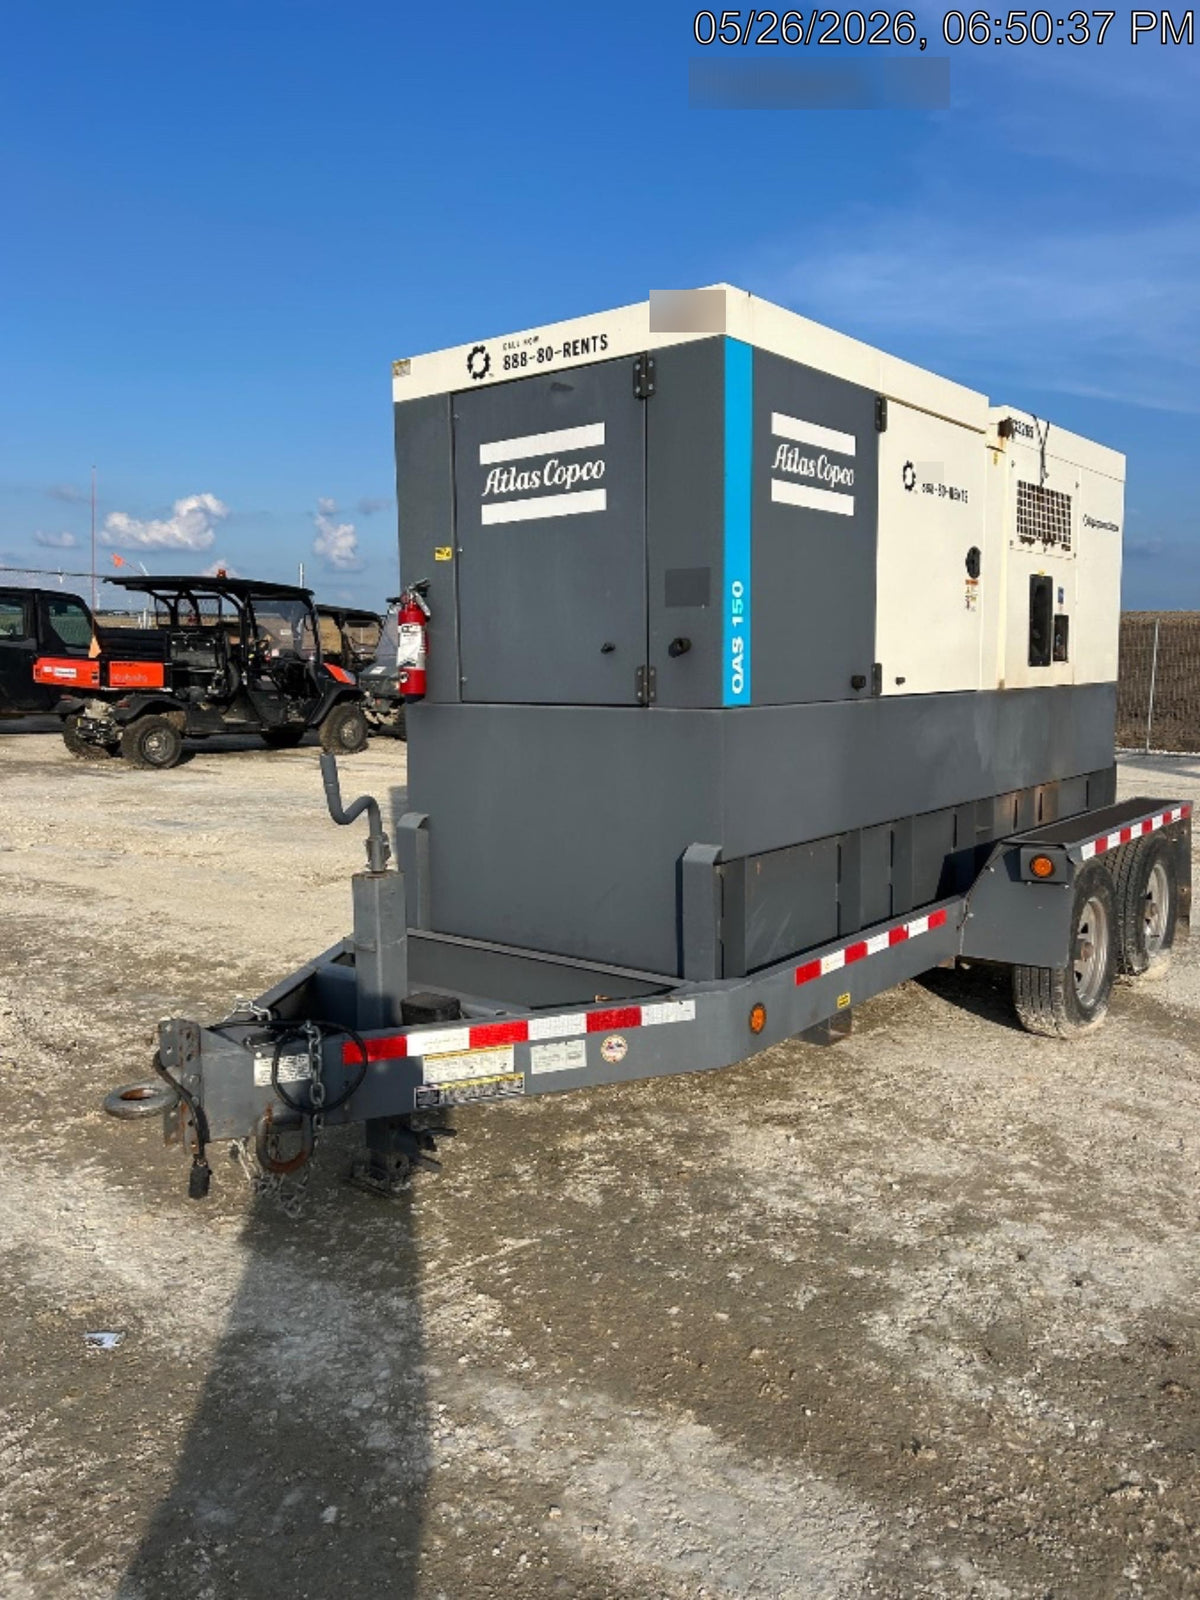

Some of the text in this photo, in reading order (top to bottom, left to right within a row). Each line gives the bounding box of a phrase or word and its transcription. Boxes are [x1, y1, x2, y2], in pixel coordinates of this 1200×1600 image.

[502, 333, 609, 371] 888-80-RENTS
[480, 458, 606, 497] Atlas Copco
[770, 443, 855, 489] Atlas Copco
[731, 580, 744, 628] 150
